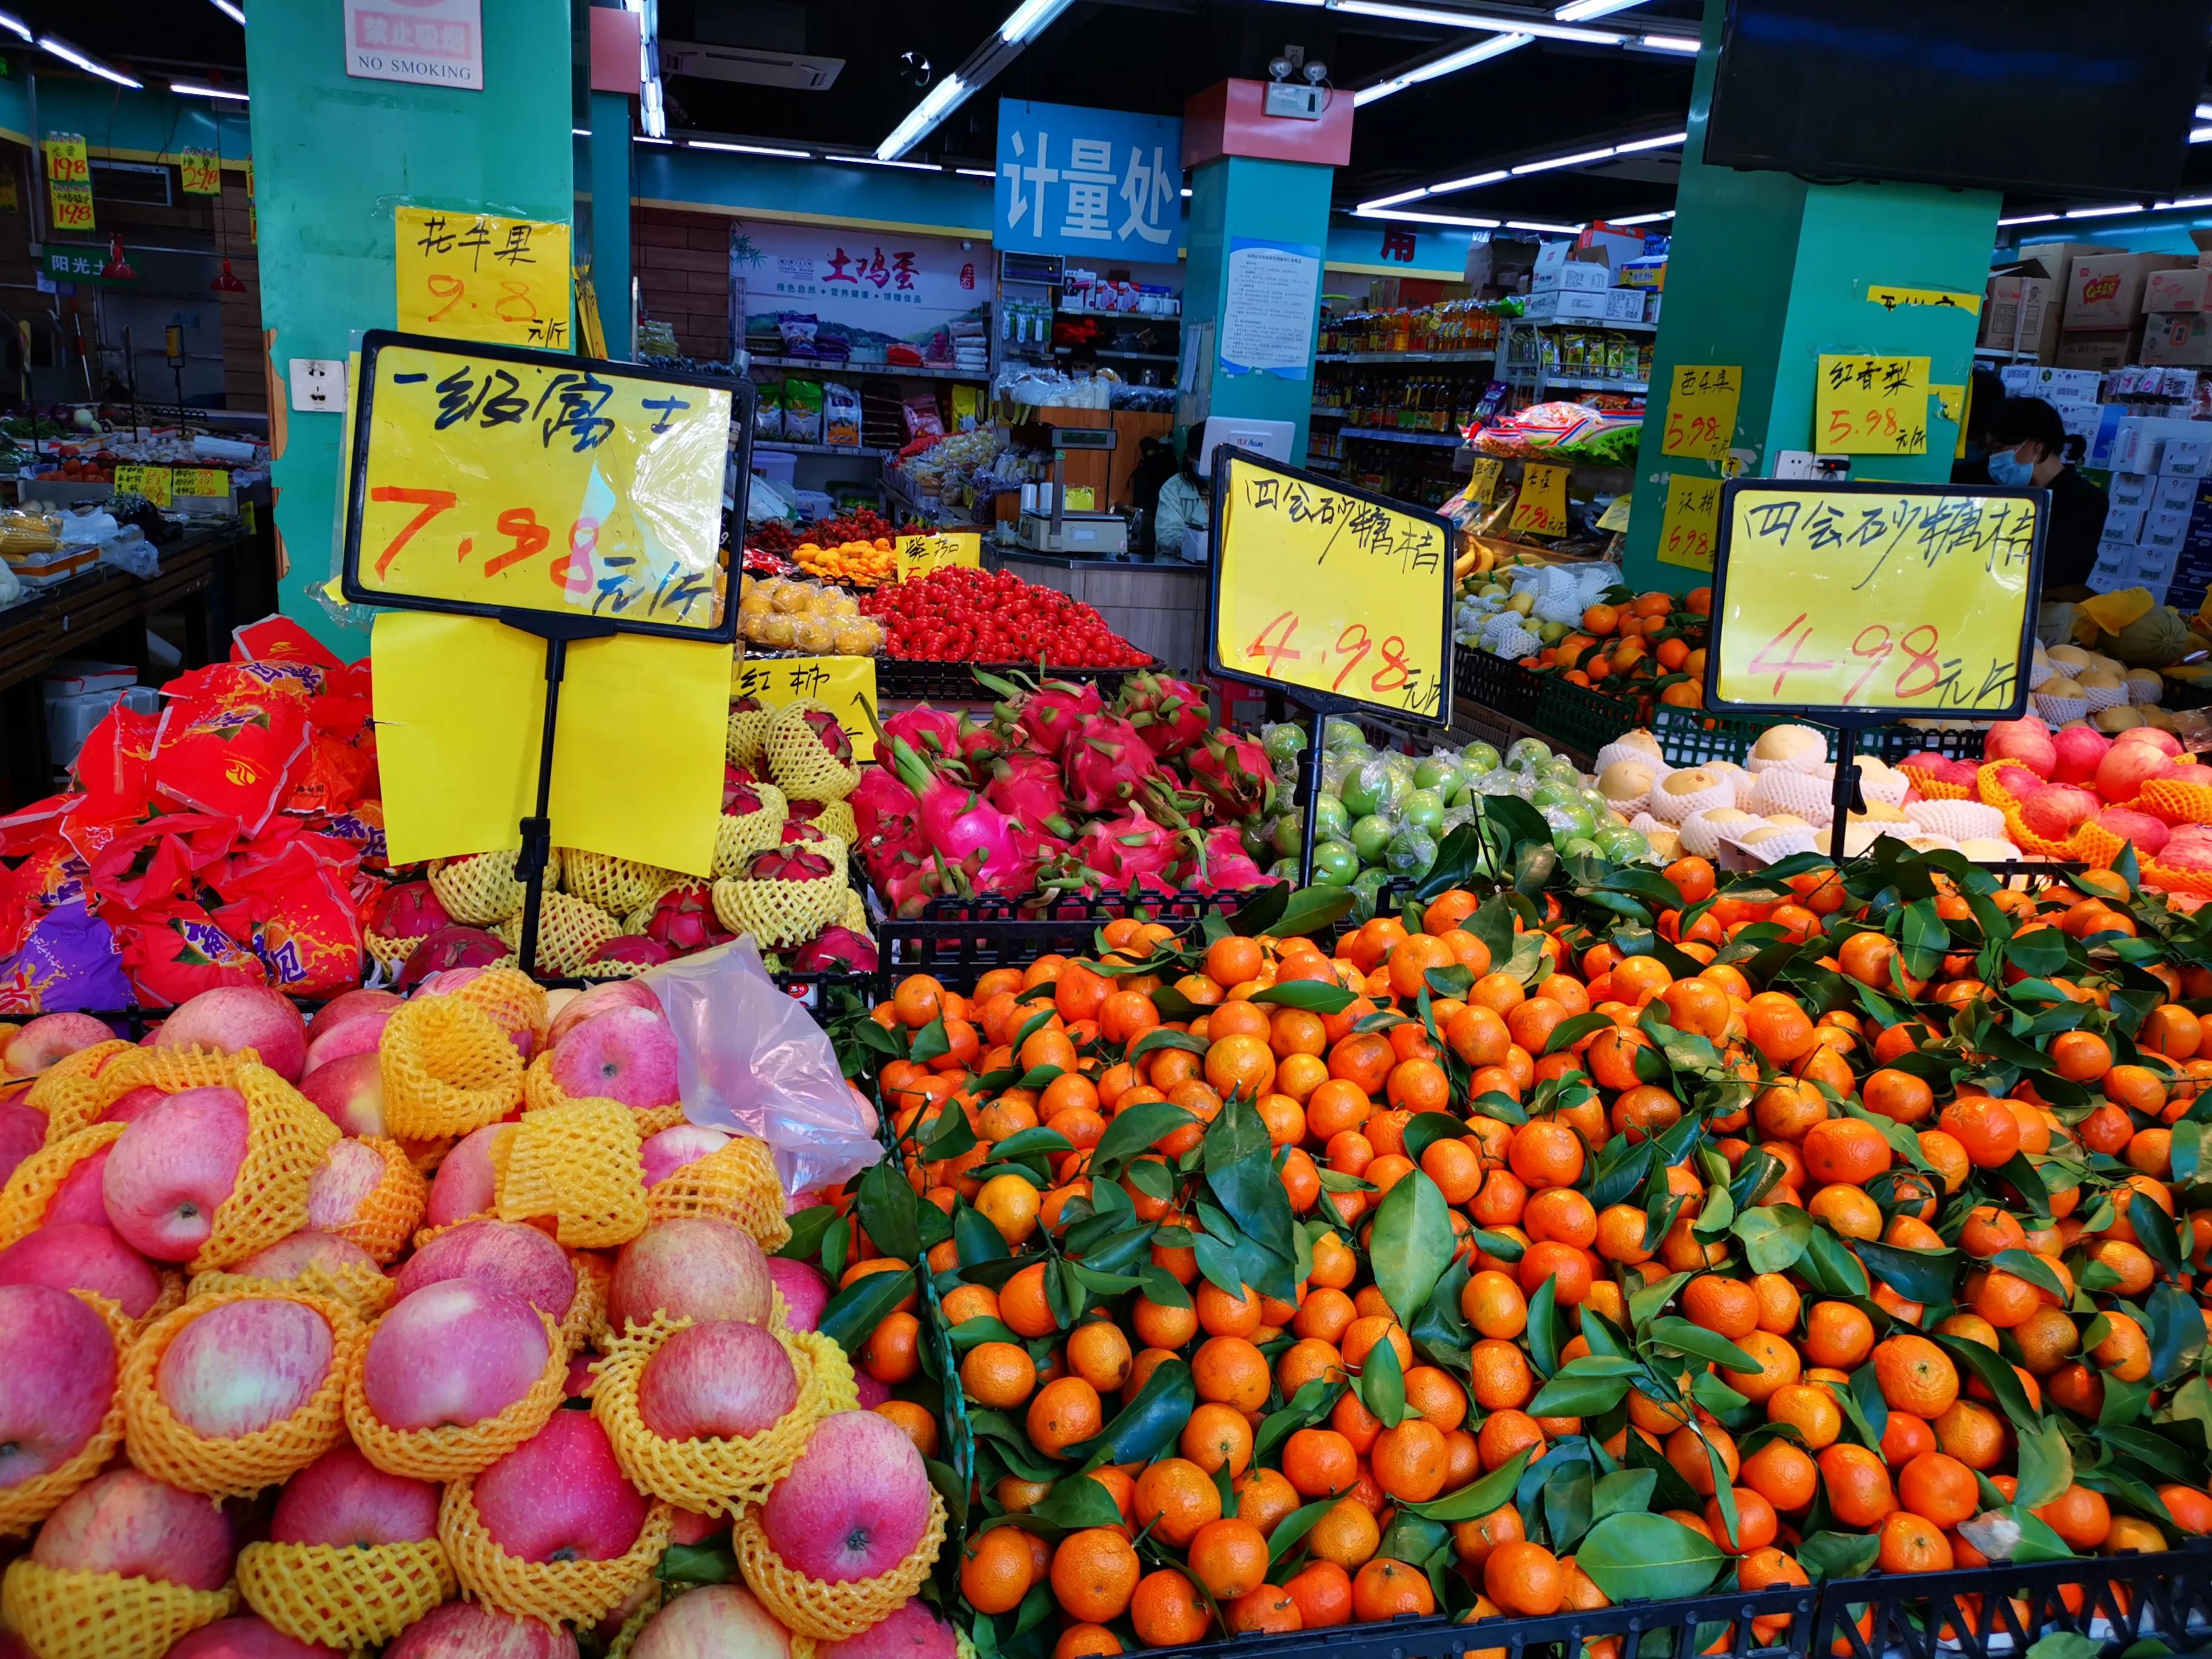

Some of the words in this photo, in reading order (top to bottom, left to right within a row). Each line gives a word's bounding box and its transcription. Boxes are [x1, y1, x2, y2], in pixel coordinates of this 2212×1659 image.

[363, 16, 464, 55] 禁止吸烟
[358, 56, 383, 70] NO
[391, 59, 471, 80] SMOKING
[1002, 130, 1175, 245] 计量处
[59, 204, 92, 224] 19.8
[418, 216, 536, 272] 花牛果
[52, 255, 115, 276] 阳光土
[822, 247, 920, 290] 土鸡蛋
[960, 265, 974, 290] 生态
[427, 275, 538, 323] 9.8
[776, 283, 816, 294] 绿色自然
[831, 287, 870, 300] 营养健康
[883, 292, 922, 304] 馈赠佳品
[1829, 360, 1915, 397] 红香梨
[394, 366, 690, 452] 一级富士
[1828, 407, 1898, 446] 5.98
[1668, 413, 1721, 450] 5.98
[1514, 504, 1548, 529] 7.98
[1678, 486, 1717, 515] 沃柑
[371, 486, 599, 594] 7.98
[1245, 478, 1439, 574] 四会砂糖桔
[1669, 525, 1708, 557] 6.98
[1744, 498, 2036, 591] 四会砂糖桔
[592, 557, 712, 623] 元/斤
[1247, 611, 1409, 692] 4.98
[1748, 612, 1940, 705] 4.98
[740, 663, 830, 698] 红柿
